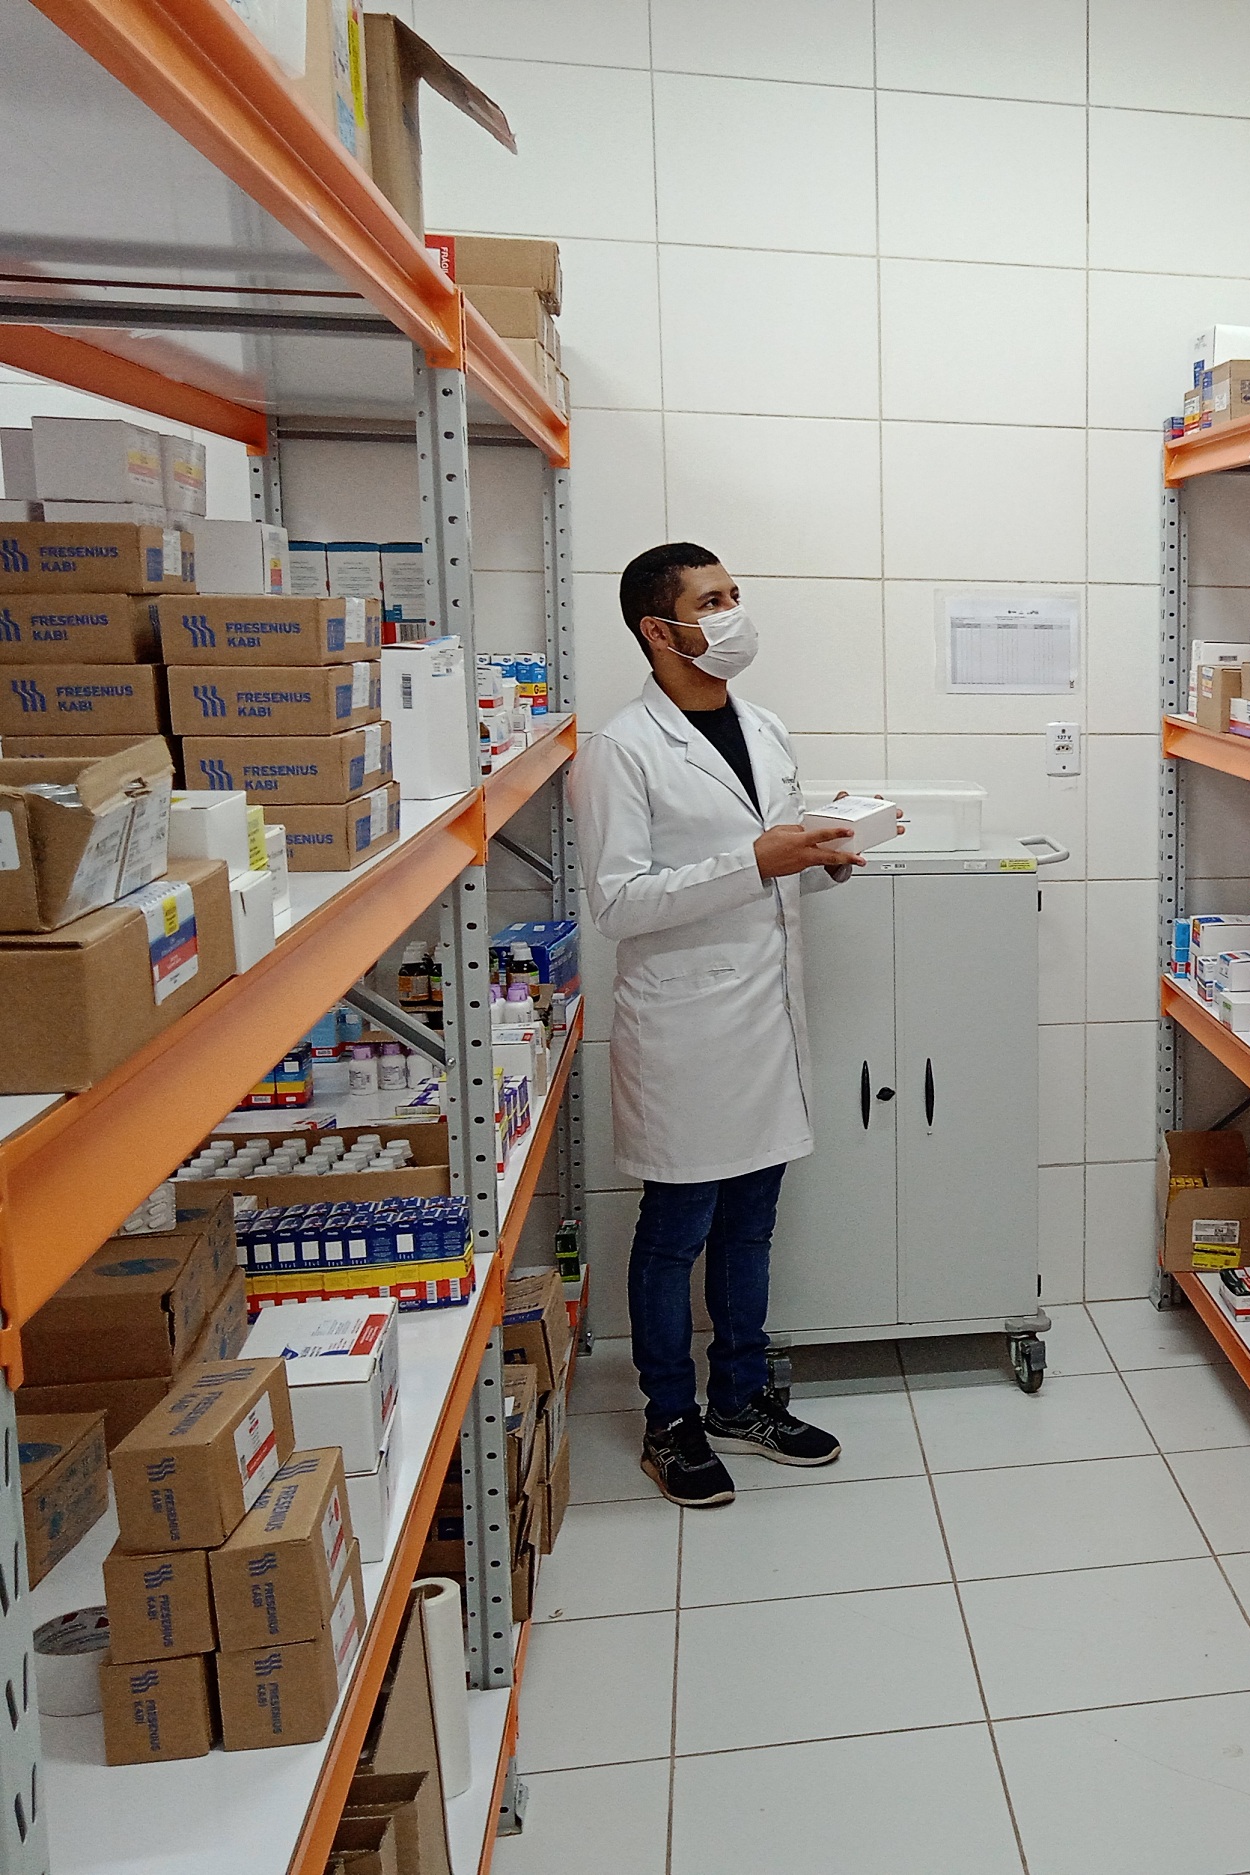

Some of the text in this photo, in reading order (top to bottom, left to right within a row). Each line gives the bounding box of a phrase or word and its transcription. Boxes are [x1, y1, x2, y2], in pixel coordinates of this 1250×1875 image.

[39, 546, 119, 558] FRESENIUS
[41, 561, 77, 572] KABI
[30, 614, 109, 627] FRESENIUS
[225, 622, 301, 634] FRESENIUS
[32, 629, 68, 641] KABI
[227, 637, 261, 648] KABI
[56, 685, 133, 698] FRESENIUS
[236, 691, 312, 704] FRESENIUS
[58, 700, 93, 712] KABI
[237, 706, 272, 717] KABI
[243, 765, 319, 777] FRESENIUS
[244, 779, 279, 791] KABI
